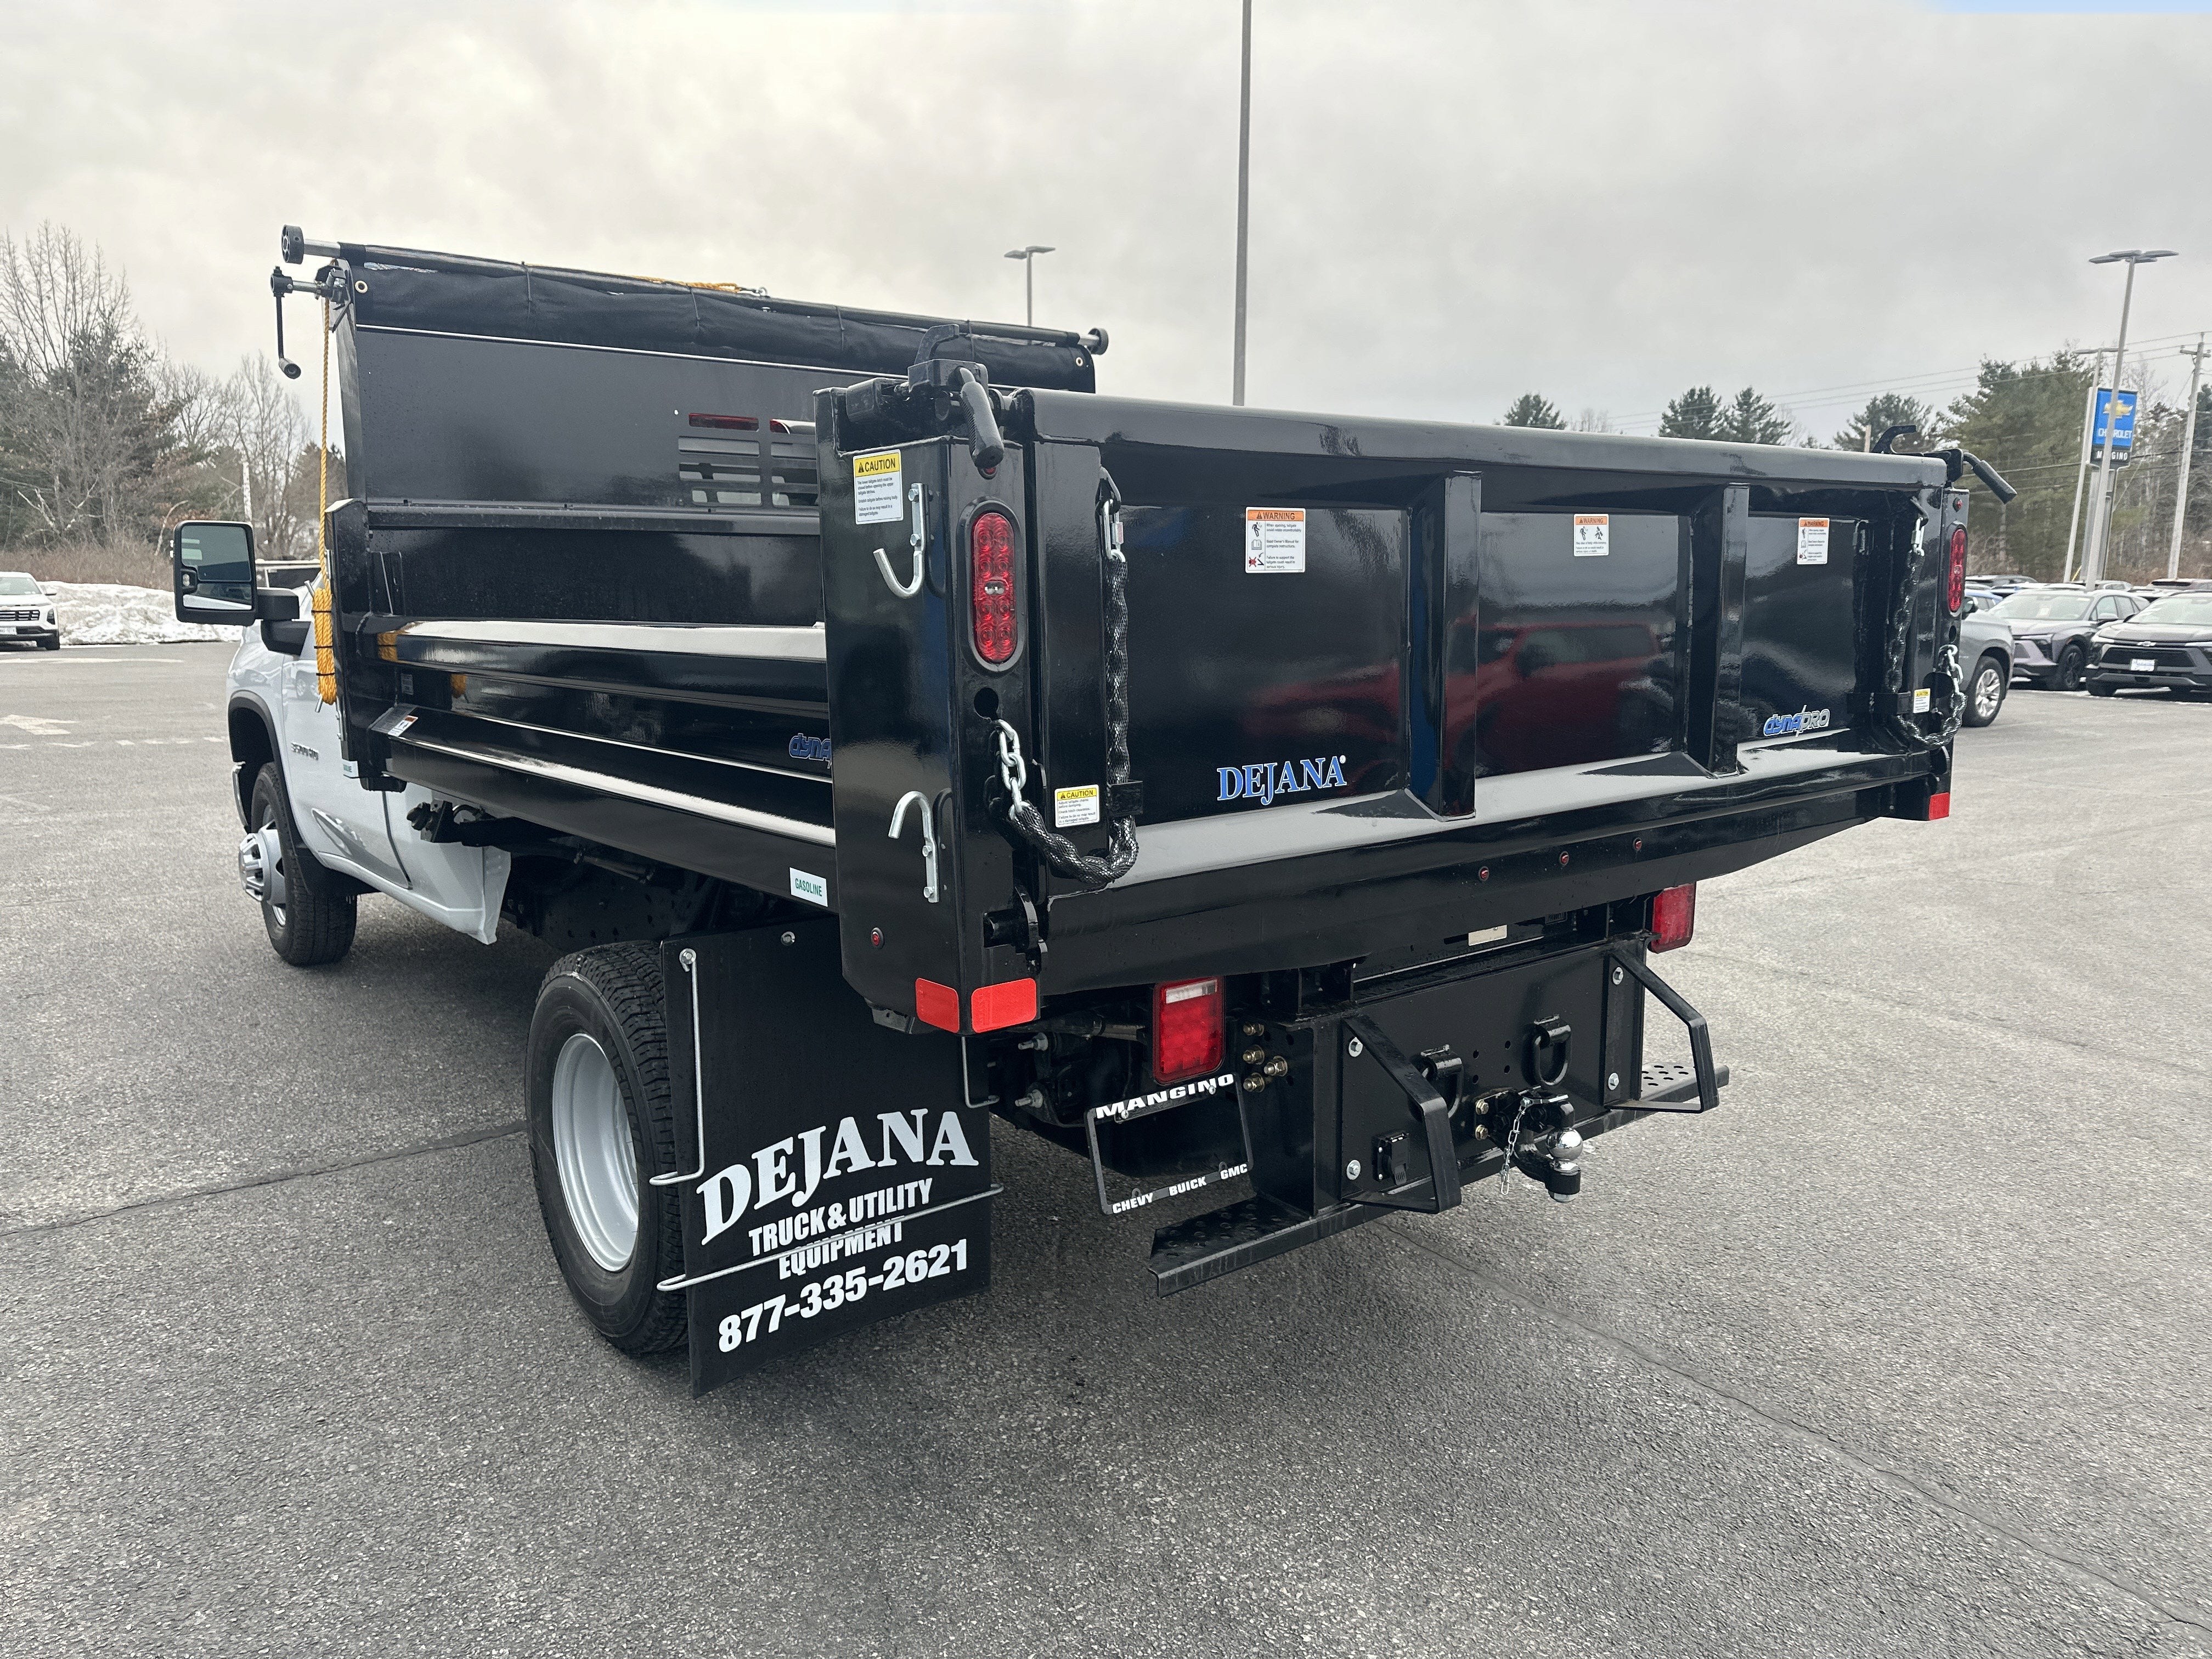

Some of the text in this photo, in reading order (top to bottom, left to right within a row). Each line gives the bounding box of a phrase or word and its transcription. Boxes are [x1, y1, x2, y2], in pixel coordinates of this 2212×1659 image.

[2098, 428, 2132, 439] CHROLET
[2096, 450, 2128, 460] MGINO
[865, 458, 895, 472] CAUTION
[1263, 512, 1295, 520] WARNING
[1217, 756, 1347, 805] DEJANA
[1066, 790, 1093, 798] CAUTION
[795, 878, 822, 896] GASOLINE
[1096, 1074, 1234, 1119] MANGINO
[696, 1108, 979, 1245] DEJANA
[1220, 1164, 1248, 1180] GMC
[1169, 1176, 1207, 1196] BUICK
[1112, 1193, 1153, 1214] CHEVY
[778, 1216, 905, 1280] EQUIPMENT
[718, 1238, 967, 1352] 877-335-2621
